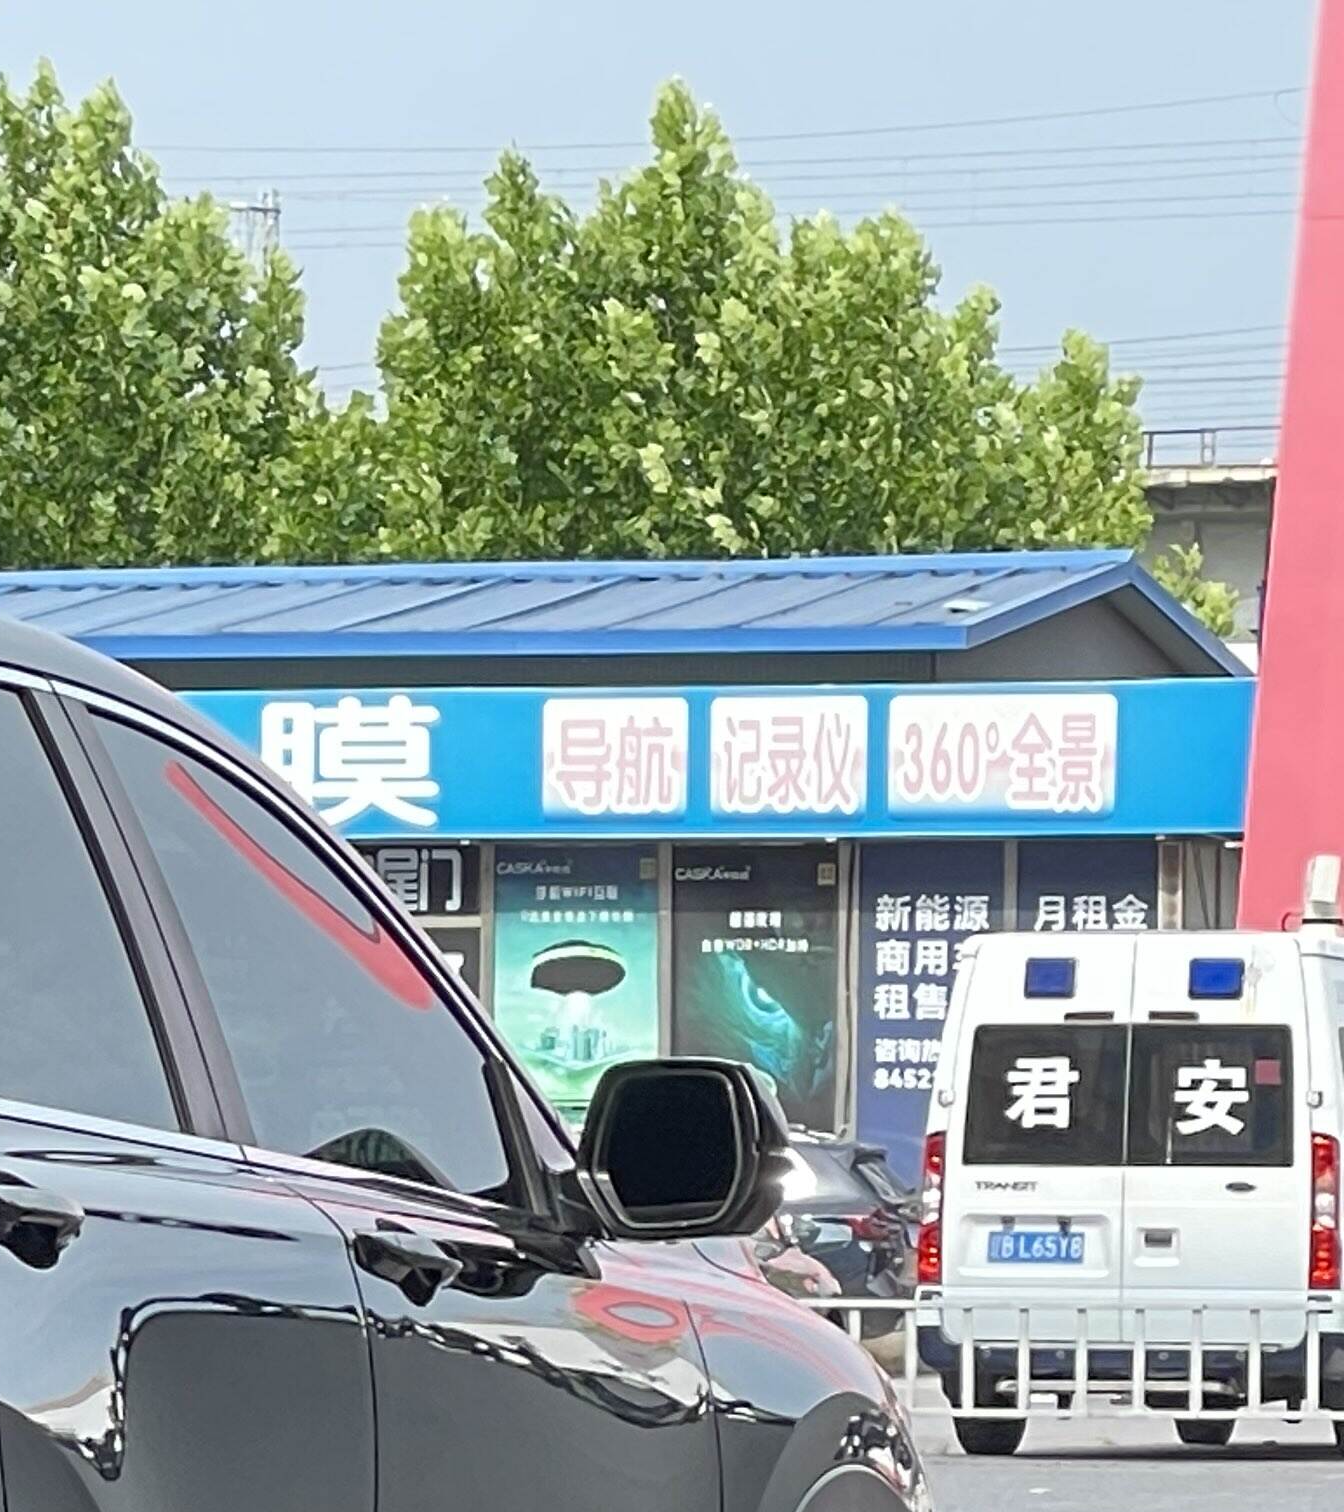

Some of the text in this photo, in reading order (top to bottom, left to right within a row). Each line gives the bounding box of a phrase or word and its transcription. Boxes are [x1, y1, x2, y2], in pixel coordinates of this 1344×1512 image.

[261, 694, 440, 828] 膜
[555, 714, 674, 808] 导航
[723, 712, 855, 810] 记录仪
[366, 847, 463, 912] 尾门
[874, 893, 1150, 933] 新能源 月租金
[873, 984, 950, 1022] 租售
[873, 1067, 935, 1090] 8452
[1004, 1056, 1250, 1137] 君 安
